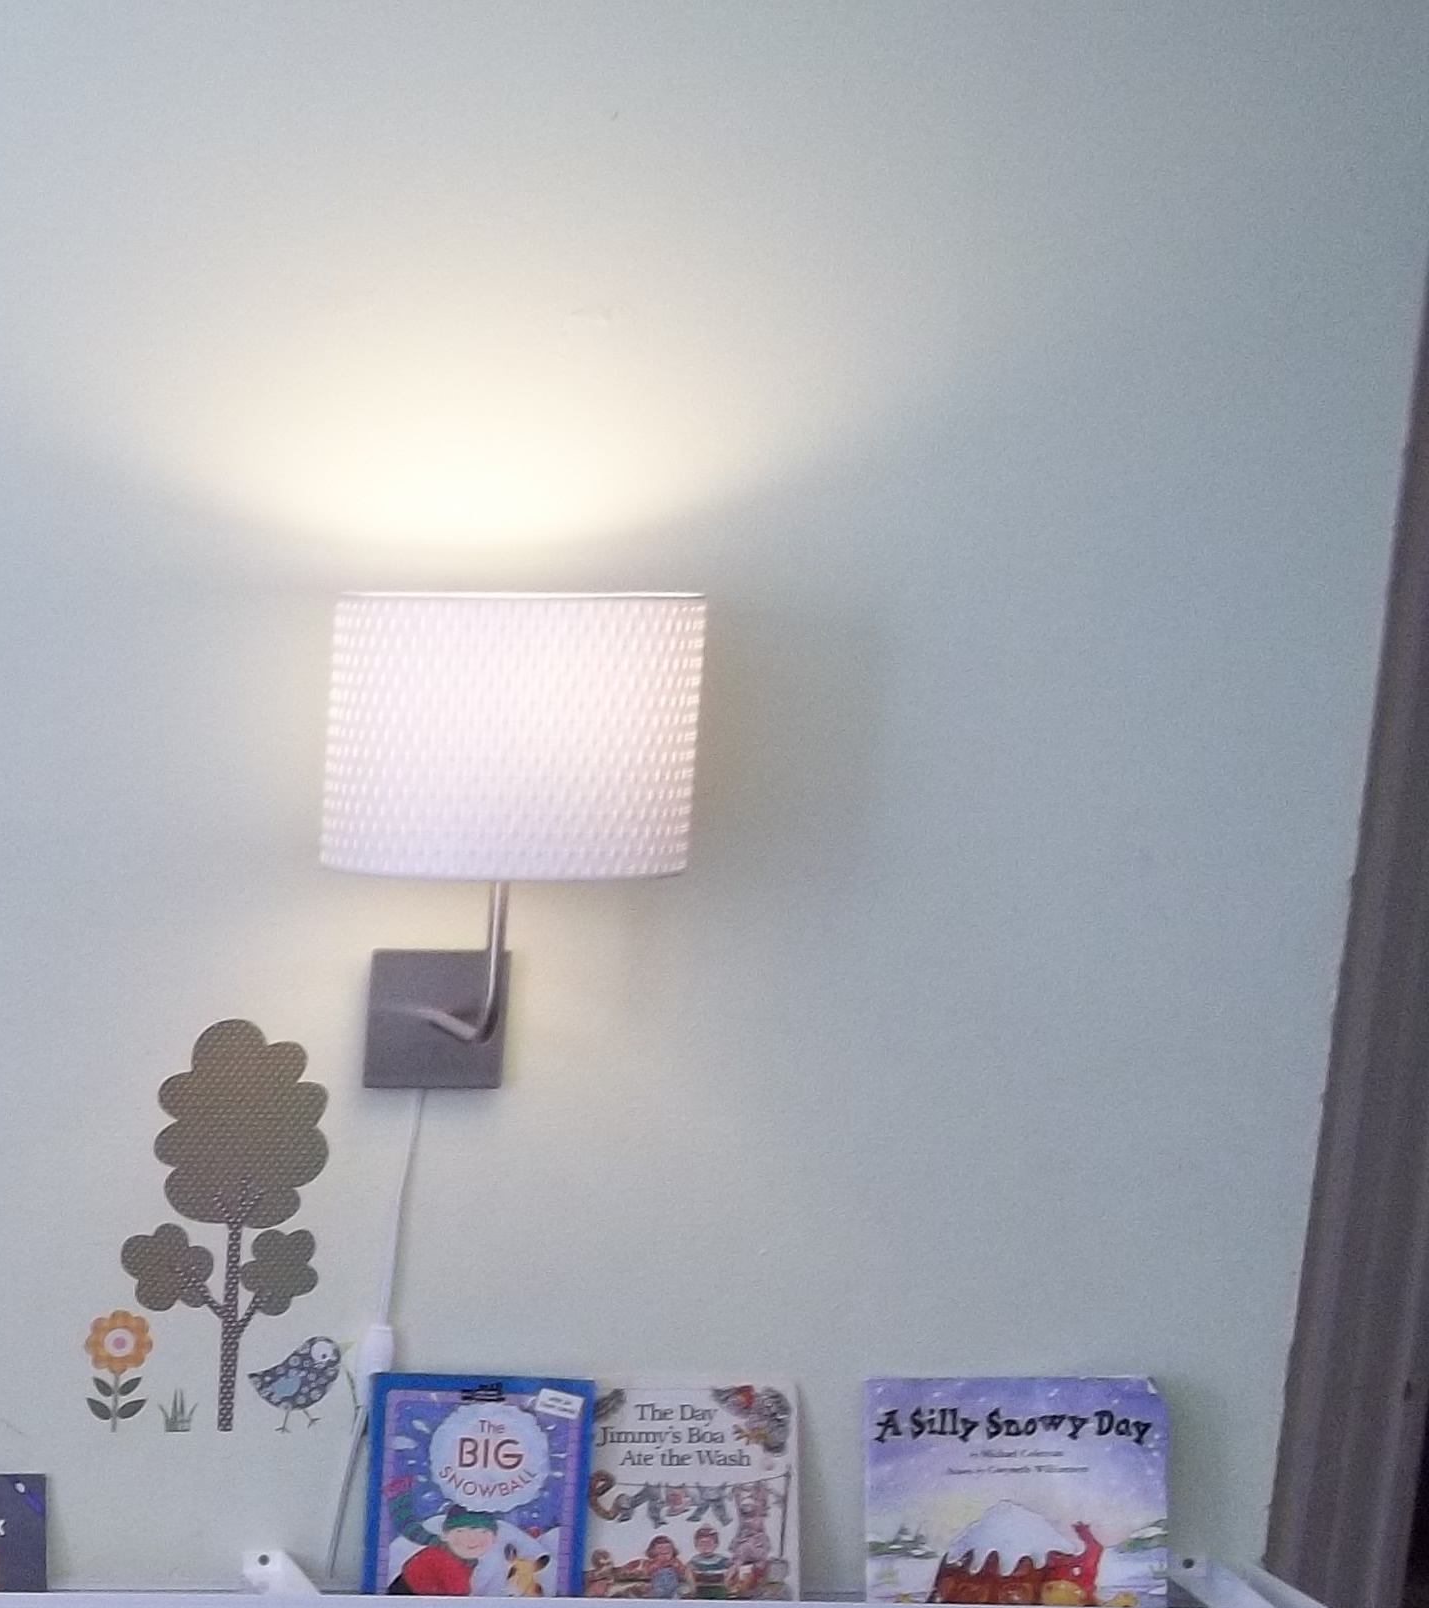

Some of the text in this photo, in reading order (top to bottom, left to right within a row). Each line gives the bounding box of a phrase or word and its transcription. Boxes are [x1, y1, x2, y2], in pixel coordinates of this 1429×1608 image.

[479, 1419, 505, 1434] The
[635, 1403, 719, 1427] The Day
[874, 1406, 1153, 1445] A Silly Snowy Day
[597, 1426, 724, 1449] Jimmy's Boa
[458, 1437, 523, 1470] BIG
[619, 1449, 751, 1467] Ate the Wash
[439, 1466, 537, 1497] SNOWBALL
